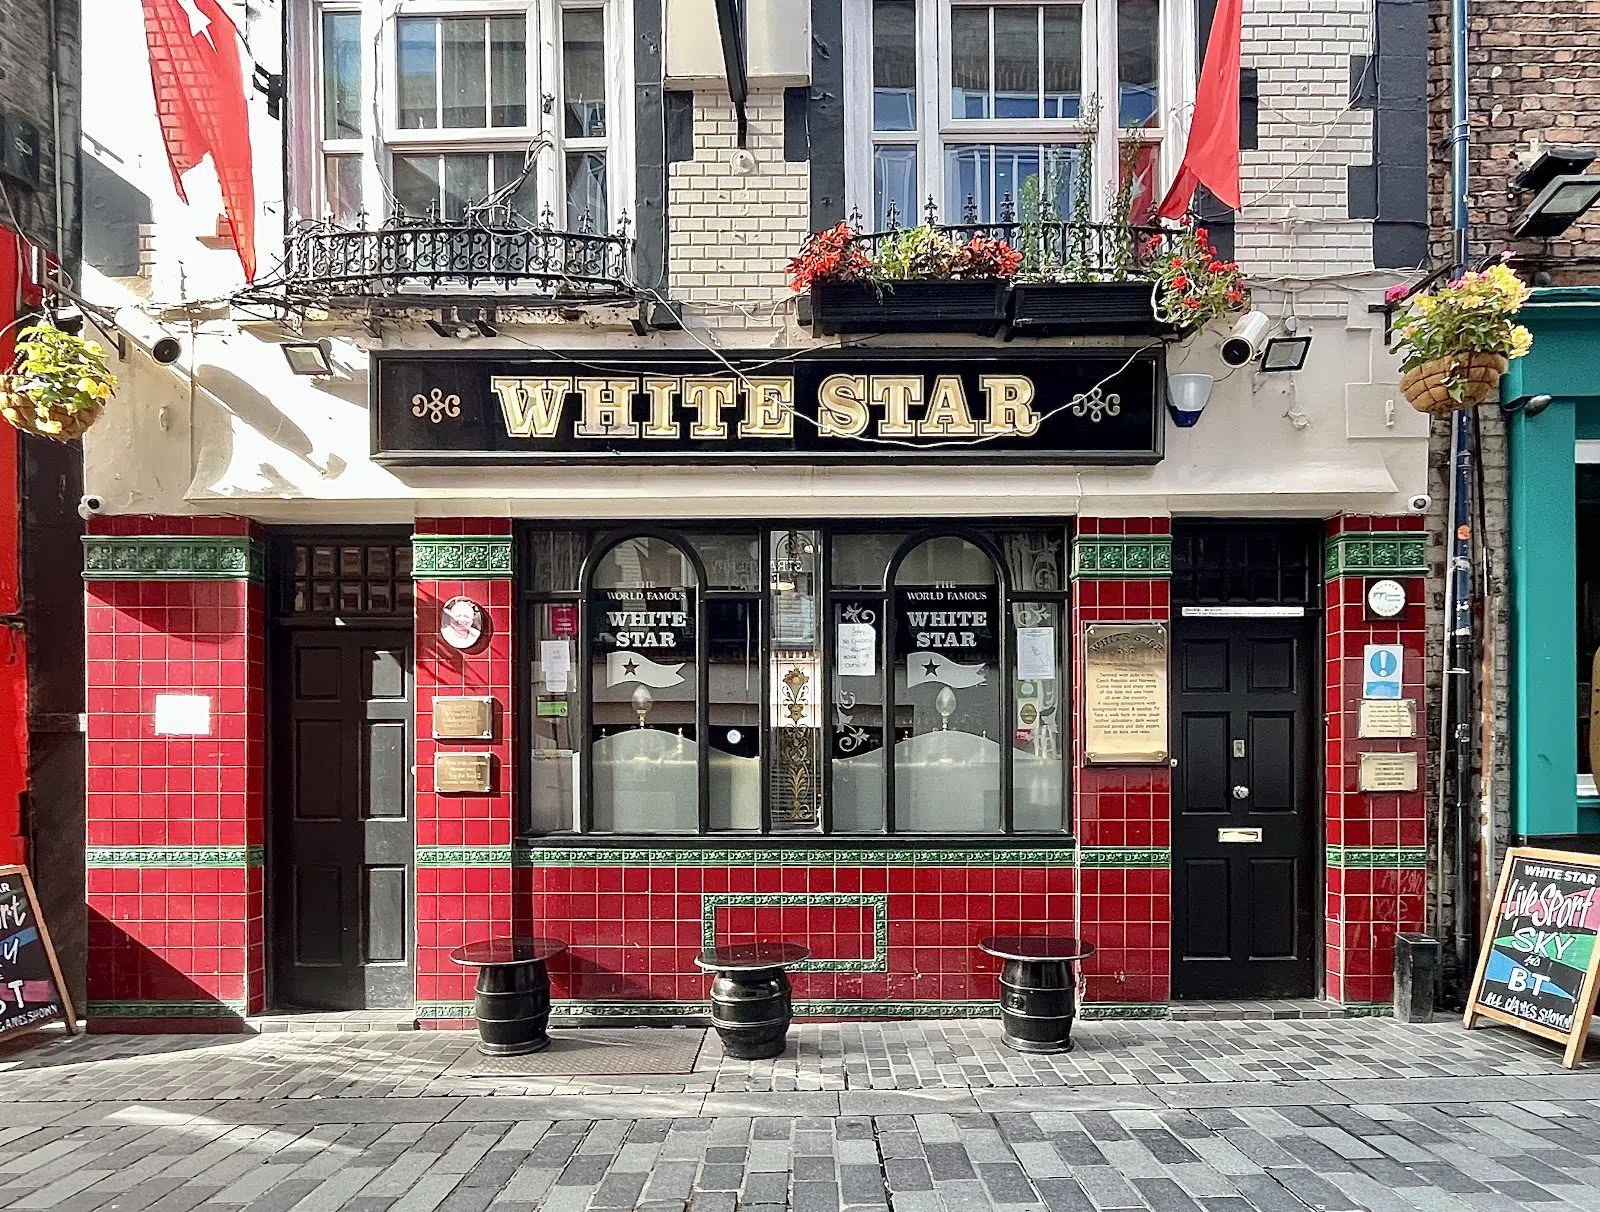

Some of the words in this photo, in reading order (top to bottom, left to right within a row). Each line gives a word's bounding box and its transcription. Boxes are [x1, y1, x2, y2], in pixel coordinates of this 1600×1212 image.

[490, 376, 795, 439] WHITE
[818, 374, 1042, 437] STAR
[606, 591, 644, 601] WORLD
[647, 591, 687, 601] FAMOUS
[906, 591, 944, 601] WORLD
[947, 591, 987, 601] FAMOUS
[606, 611, 687, 627] WHITE
[906, 611, 987, 627] WHITE
[616, 631, 677, 647] STAR
[916, 631, 977, 648] STAR
[1525, 864, 1564, 880] WHITE
[1564, 870, 1598, 885] STAR
[1511, 926, 1577, 960] SKY
[1508, 966, 1551, 997] BT
[1486, 991, 1502, 1006] ALL
[1504, 996, 1538, 1019] GAMES
[1538, 1008, 1573, 1029] SHOWN
